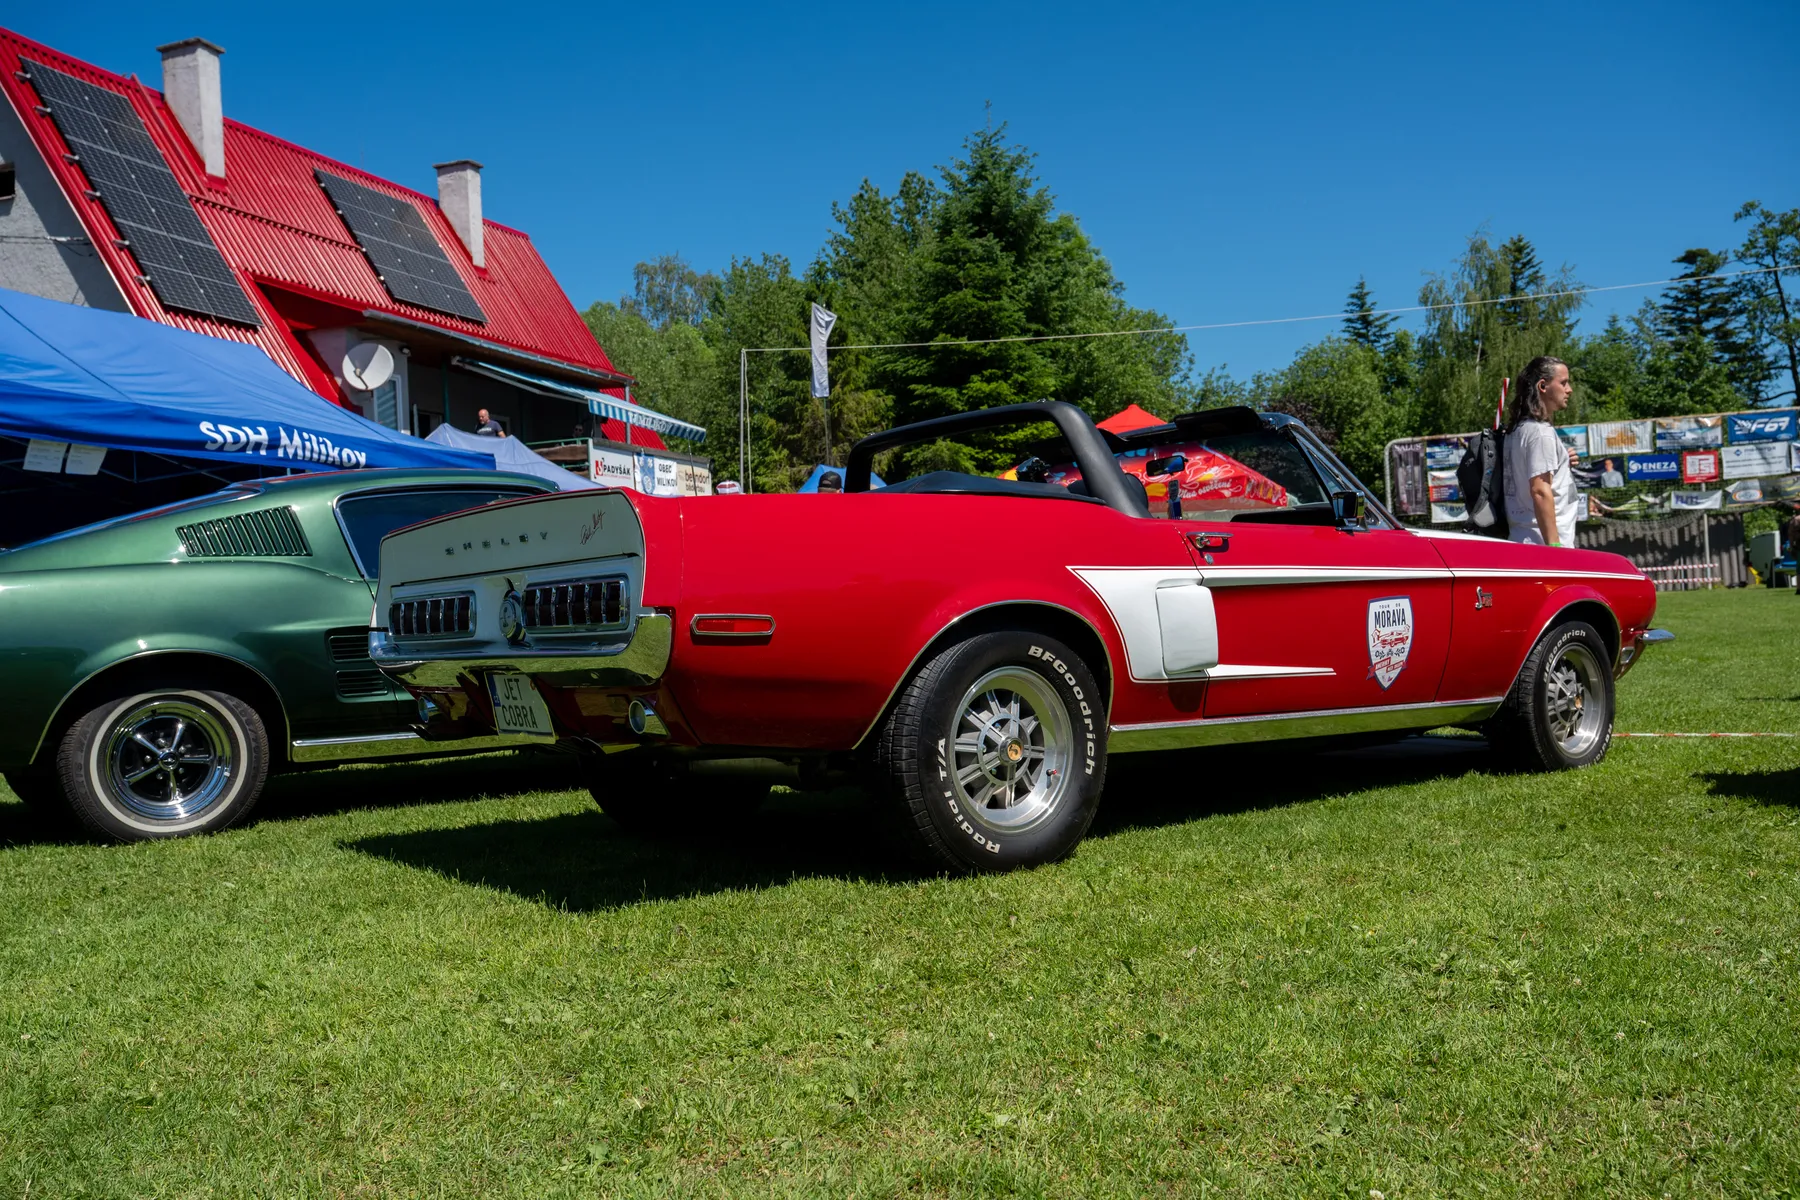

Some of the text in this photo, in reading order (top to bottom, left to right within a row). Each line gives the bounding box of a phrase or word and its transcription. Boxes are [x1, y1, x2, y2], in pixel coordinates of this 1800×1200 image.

[199, 421, 270, 456] SDH
[658, 463, 672, 473] OBEC
[1642, 461, 1677, 470] ENEZA
[444, 531, 549, 556] SHELBY
[1374, 608, 1408, 629] MORAVA
[503, 678, 523, 701] JET
[501, 704, 539, 729] COBRA
[1027, 645, 1097, 775] BFGoodrich
[937, 737, 952, 782] T/A
[944, 791, 1001, 854] Radial
